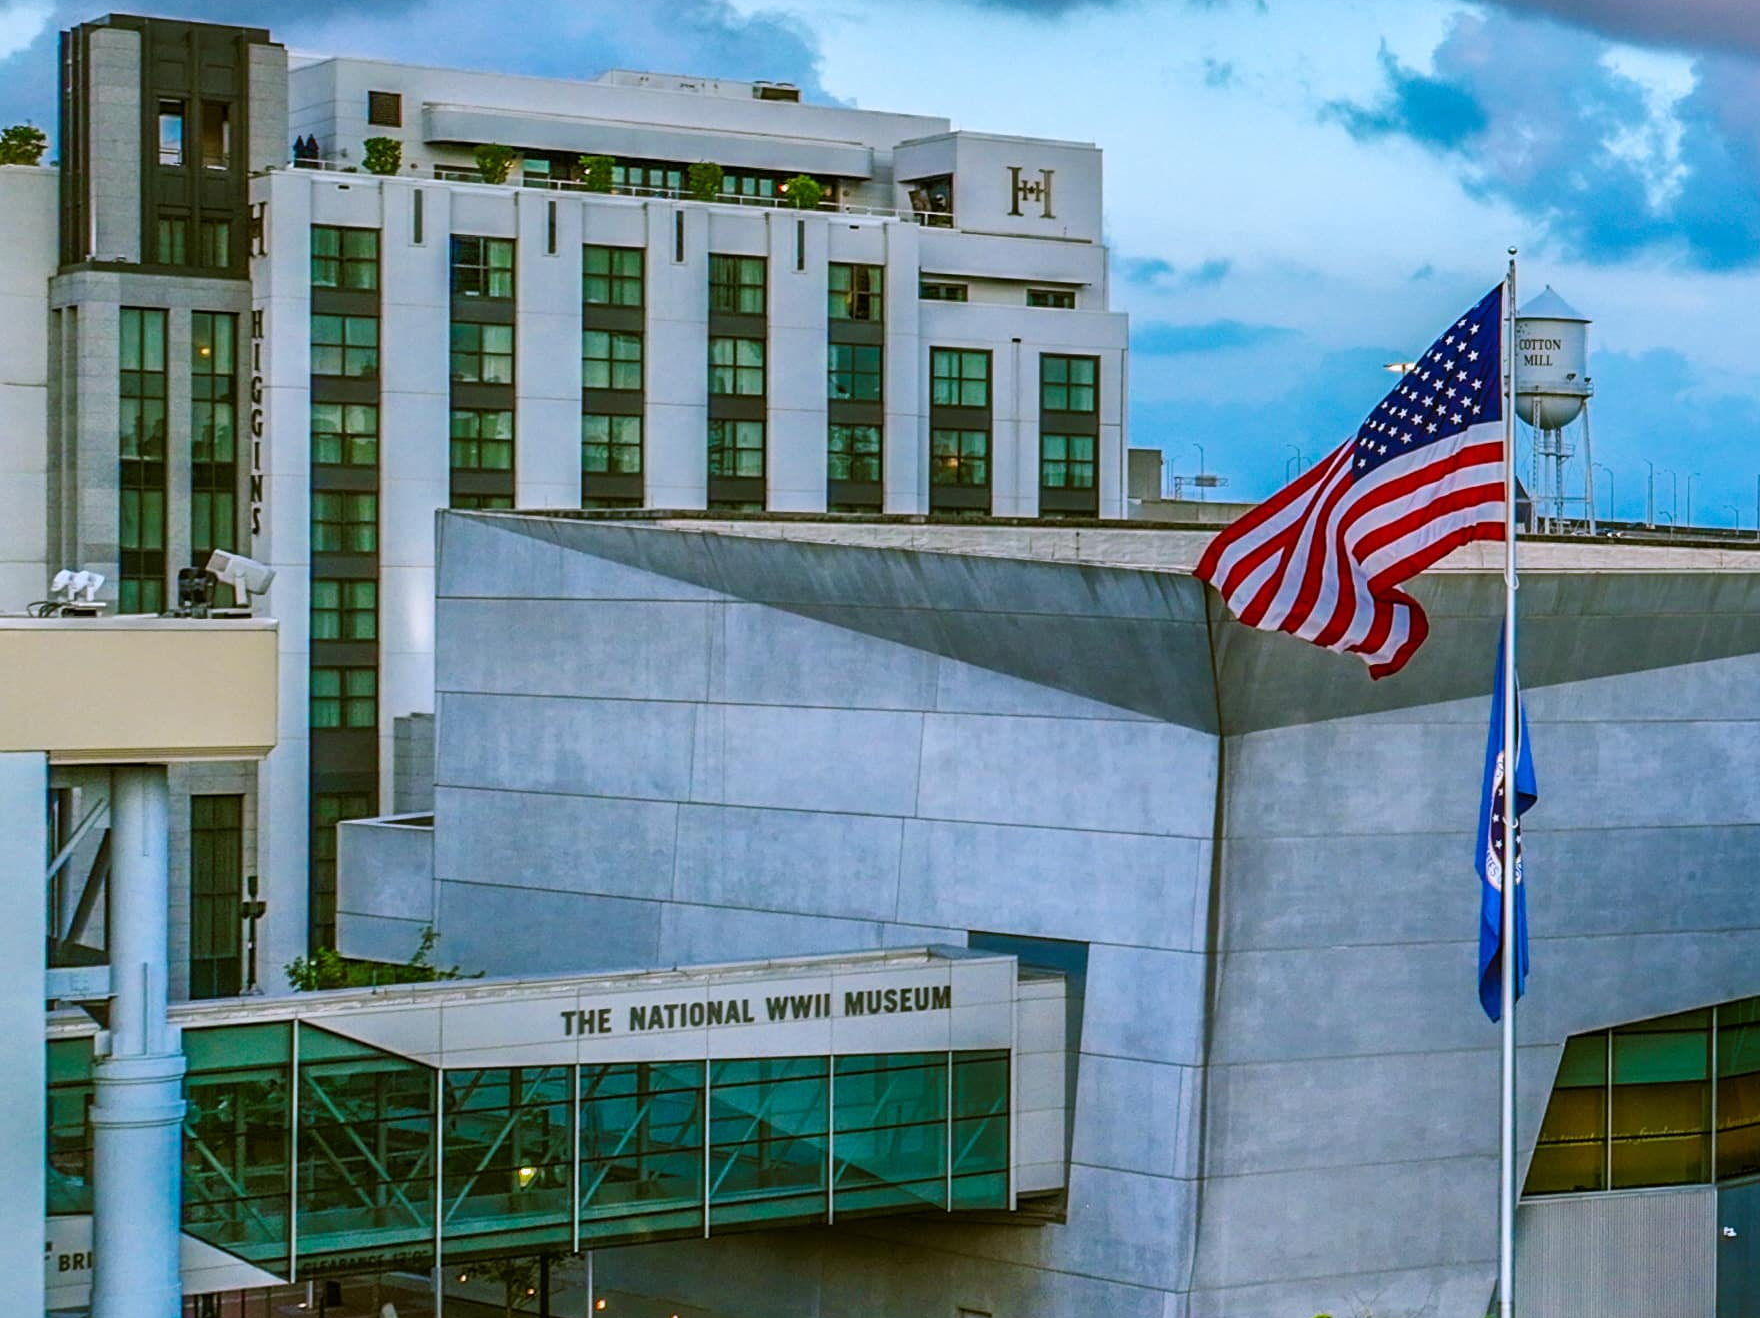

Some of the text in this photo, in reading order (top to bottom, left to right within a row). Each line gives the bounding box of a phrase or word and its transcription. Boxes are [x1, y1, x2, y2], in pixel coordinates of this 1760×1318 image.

[1519, 339, 1561, 351] COTTON
[1523, 355, 1553, 367] MILL
[251, 310, 264, 534] HIGGINS
[560, 985, 952, 1036] THE NATIONAL WWII MUSEUM
